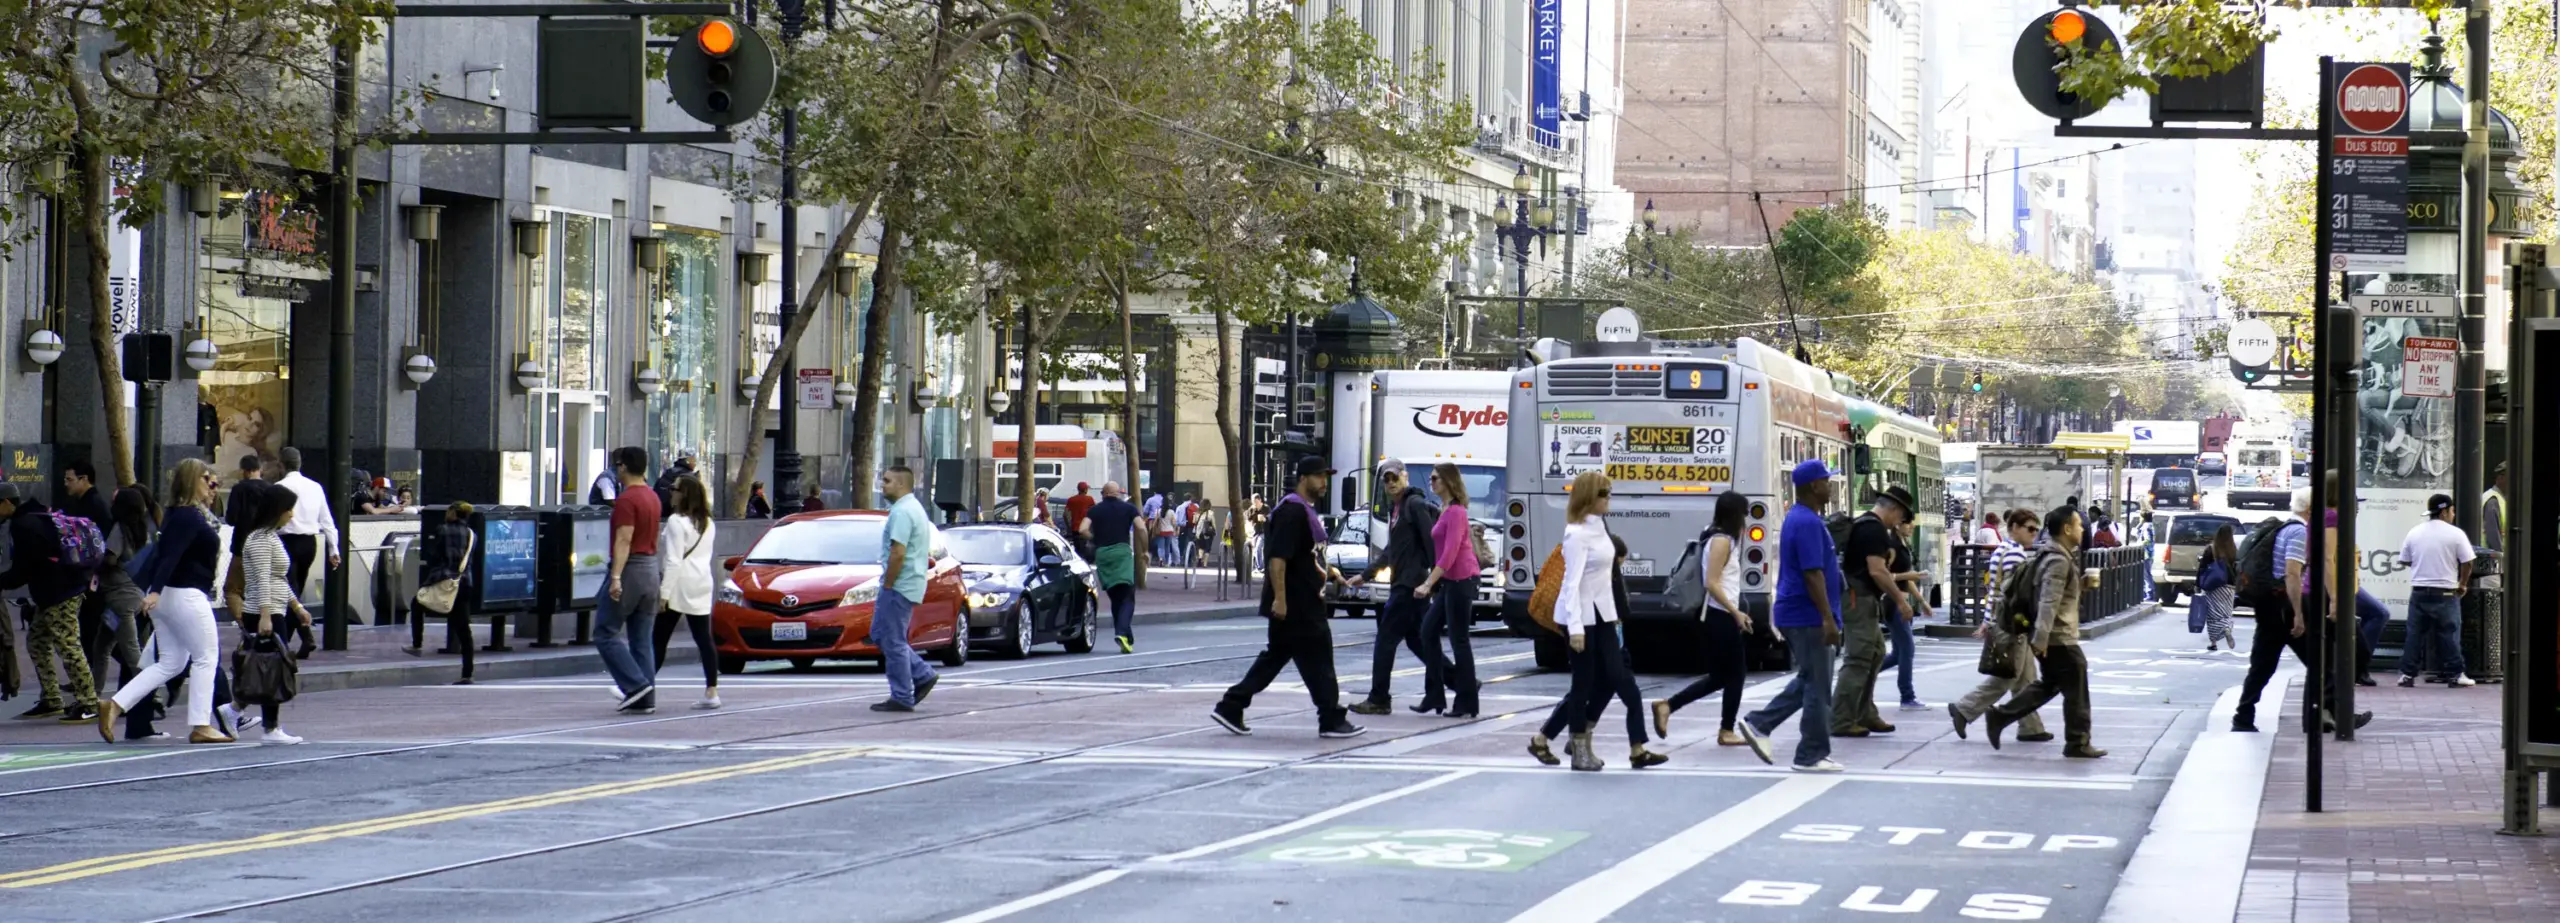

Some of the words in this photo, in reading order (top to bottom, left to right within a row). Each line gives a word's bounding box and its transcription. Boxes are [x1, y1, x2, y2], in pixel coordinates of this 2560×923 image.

[2345, 138, 2367, 152] bus
[2370, 139, 2397, 155] stop
[2332, 194, 2348, 210] 21
[2332, 213, 2348, 229] 31
[110, 276, 124, 333] Powell
[2370, 300, 2434, 313] POWELL
[1604, 326, 1632, 335] FIFTH
[2238, 339, 2269, 347] FIFTH
[2409, 339, 2453, 348] TOW-AWAY
[2406, 349, 2420, 360] NO
[2421, 351, 2454, 362] STOPPING
[2420, 364, 2440, 374] ANY
[1690, 370, 1702, 389] 9
[2419, 376, 2440, 386] TIME
[1438, 403, 1508, 430] Ryde
[1683, 405, 1714, 417] 8611
[1561, 426, 1602, 435] SINGER
[1630, 428, 1691, 444] SUNSET
[1696, 446, 1725, 454] OFF
[1609, 455, 1651, 464] Warranty
[1660, 455, 1683, 464] Sales
[1693, 456, 1726, 464] Service
[1607, 464, 1730, 482] 415.564.5200
[1602, 510, 1671, 518] www.sfmta.com
[1779, 823, 2119, 852] STOP
[1717, 879, 2053, 919] BUS
